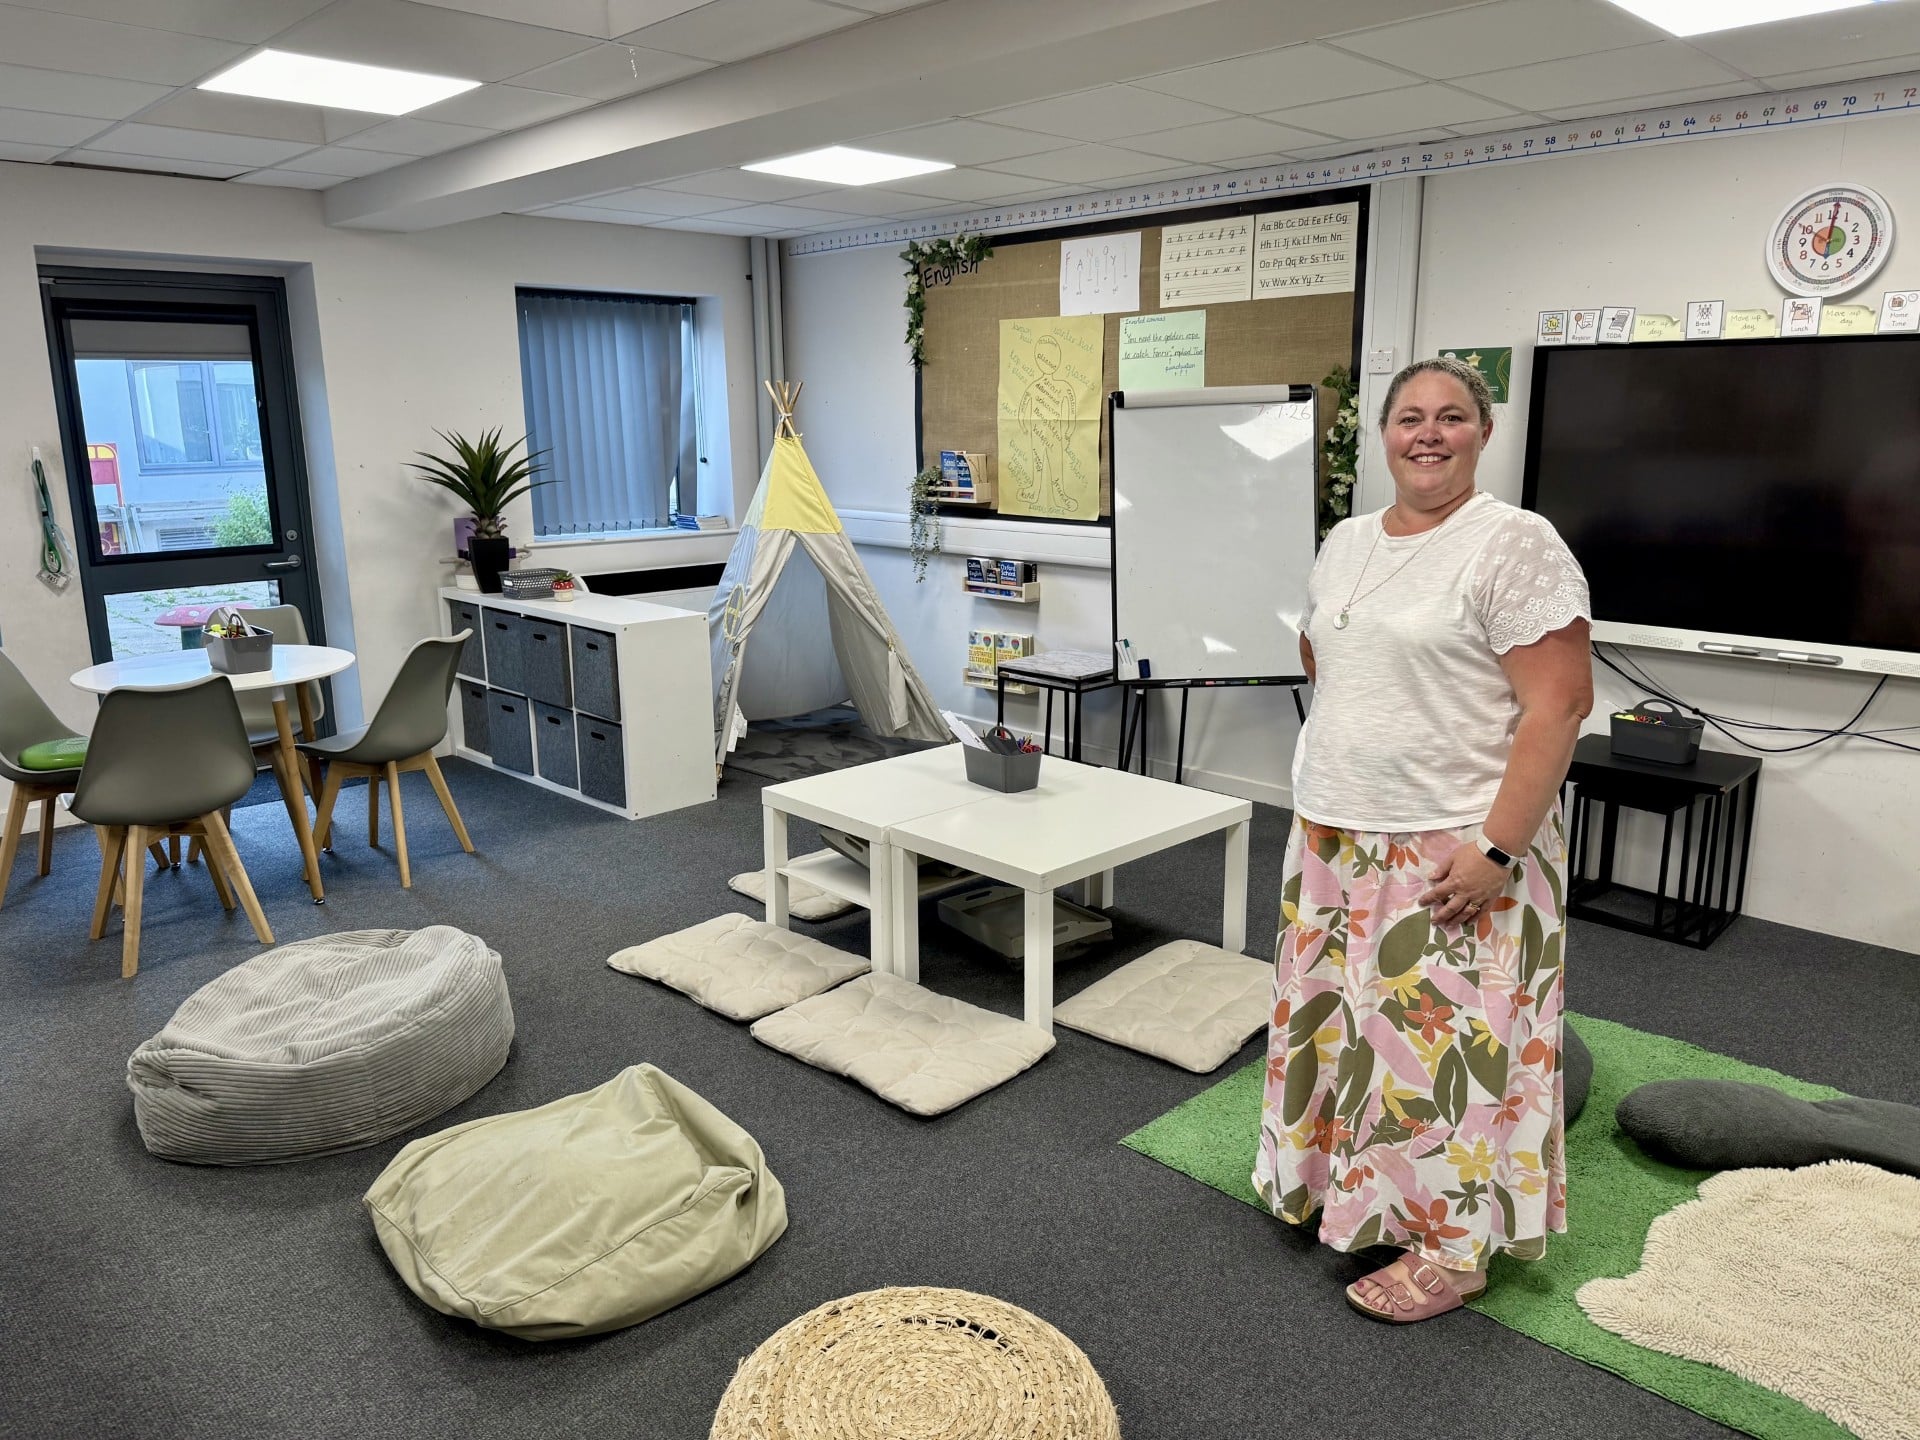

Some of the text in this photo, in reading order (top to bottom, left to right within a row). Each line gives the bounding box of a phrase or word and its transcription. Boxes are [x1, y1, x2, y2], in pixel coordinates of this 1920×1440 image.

[1422, 154, 1432, 162] 52
[1502, 143, 1512, 151] 56
[1524, 140, 1533, 148] 57
[1545, 136, 1556, 145] 58
[1568, 134, 1578, 142] 59
[1590, 130, 1602, 139] 60
[1615, 126, 1625, 135] 61
[1635, 124, 1646, 132] 62
[1659, 120, 1670, 129] 63
[1683, 117, 1696, 126] 64
[1710, 114, 1721, 123] 65
[1736, 111, 1748, 120] 66
[1763, 107, 1776, 117] 67
[1785, 104, 1799, 114] 68
[1814, 100, 1827, 110] 69
[1842, 96, 1856, 106] 70
[1874, 92, 1885, 102] 71
[1904, 88, 1916, 97] 72
[1274, 220, 1283, 229] Bb
[1286, 220, 1295, 228] Cc
[1298, 217, 1308, 226] Dd
[1312, 216, 1321, 225] Ee
[1324, 214, 1333, 223] Ff
[1336, 214, 1347, 224] Gg
[1815, 213, 1823, 223] 11
[1844, 212, 1848, 222] 1
[1802, 223, 1859, 234] 10 2
[1260, 240, 1271, 249] Hh
[1282, 238, 1288, 249] Jj
[1292, 238, 1300, 246] Kk
[1303, 235, 1309, 244] Ll
[1313, 235, 1327, 243] Mm
[1799, 236, 1860, 247] 9 3
[1800, 248, 1854, 260] 8 4
[1273, 259, 1282, 269] Pp
[1286, 258, 1296, 267] Qq
[1310, 255, 1319, 263] Ss
[1323, 254, 1330, 262] Tt
[1334, 252, 1344, 261] Uu
[1810, 259, 1842, 270] 7 6 5
[924, 253, 978, 288] English
[1290, 276, 1299, 285] Xx
[1302, 275, 1311, 286] Yy
